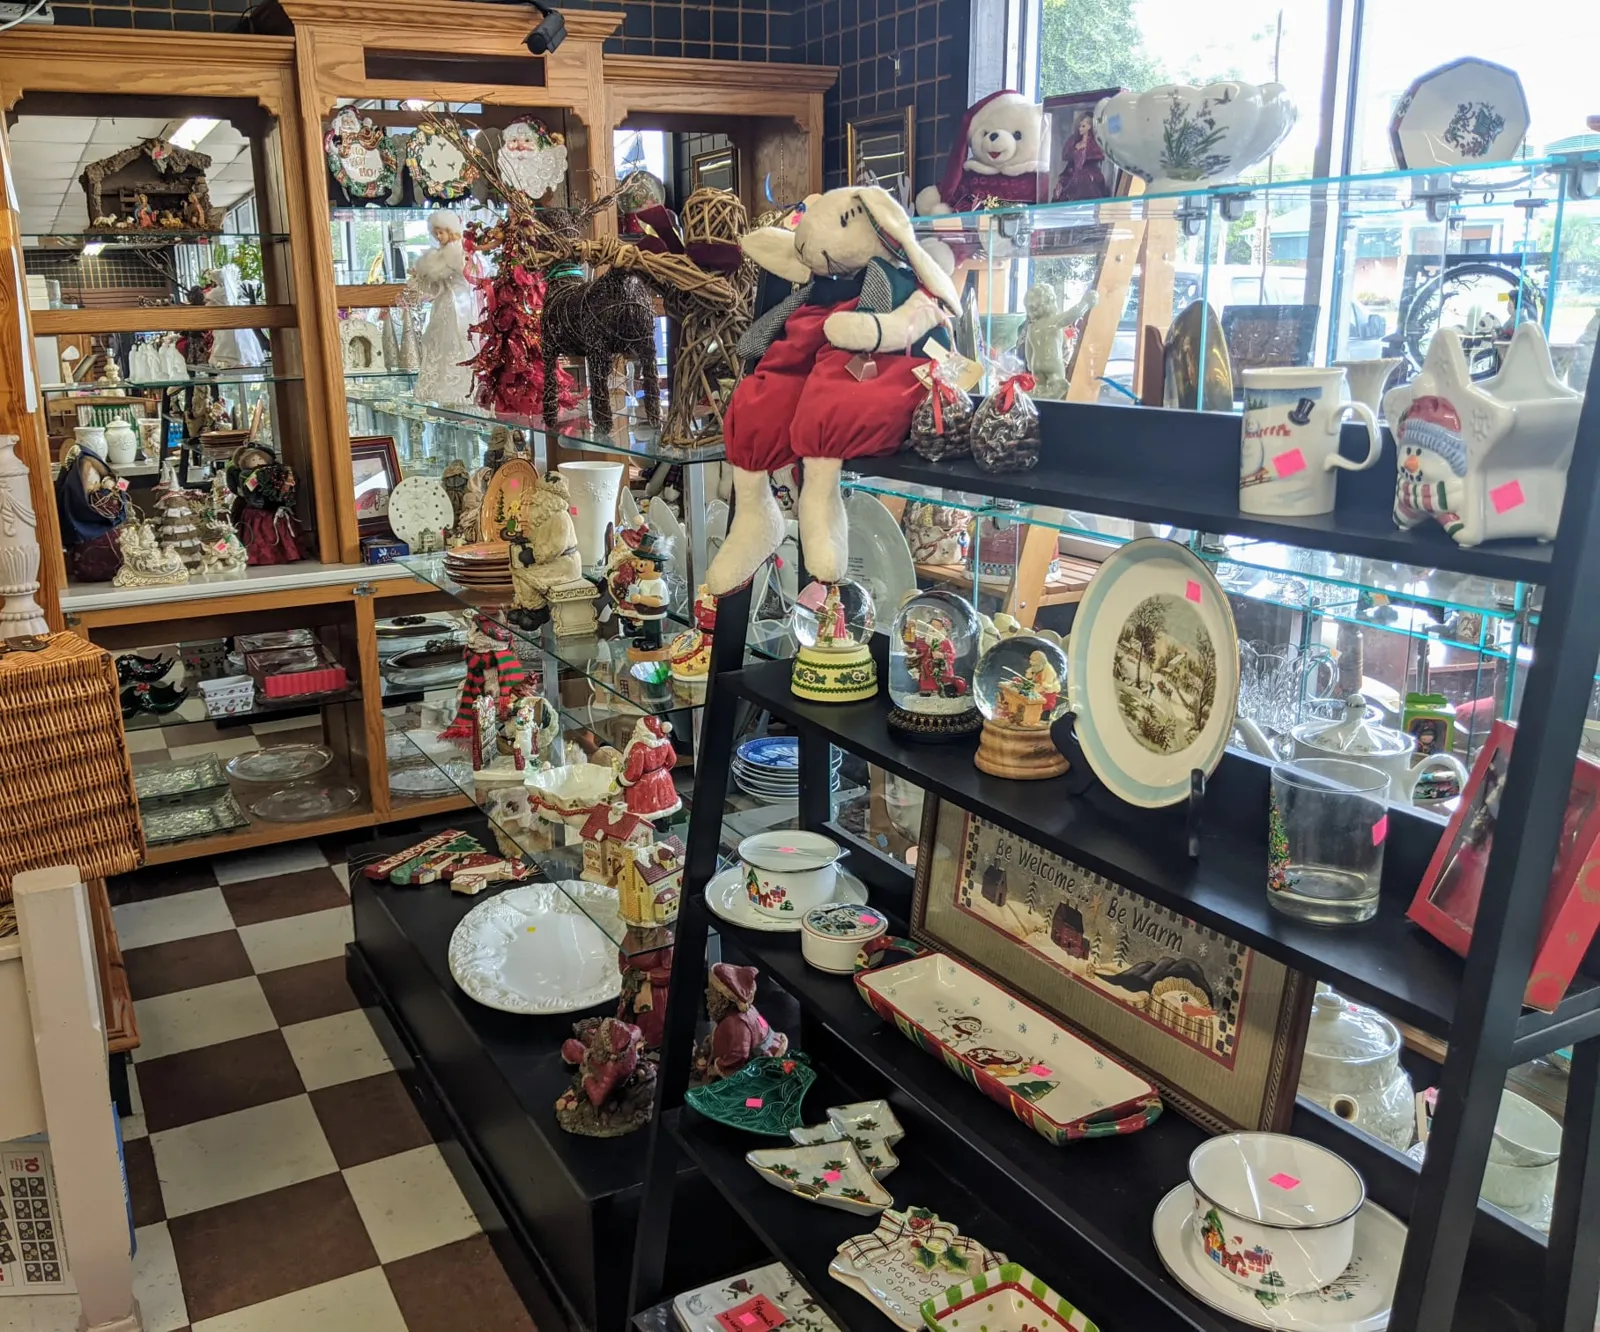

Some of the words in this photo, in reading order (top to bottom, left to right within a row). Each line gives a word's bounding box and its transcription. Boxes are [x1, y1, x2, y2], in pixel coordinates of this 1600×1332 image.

[996, 839, 1012, 861] Be
[1107, 897, 1127, 925] Be
[1133, 907, 1184, 953] Warm
[25, 1157, 40, 1173] 10
[877, 1259, 916, 1288] please
[891, 1249, 922, 1275] Dear
[919, 1273, 951, 1293] San
[892, 1285, 921, 1312] pupp
